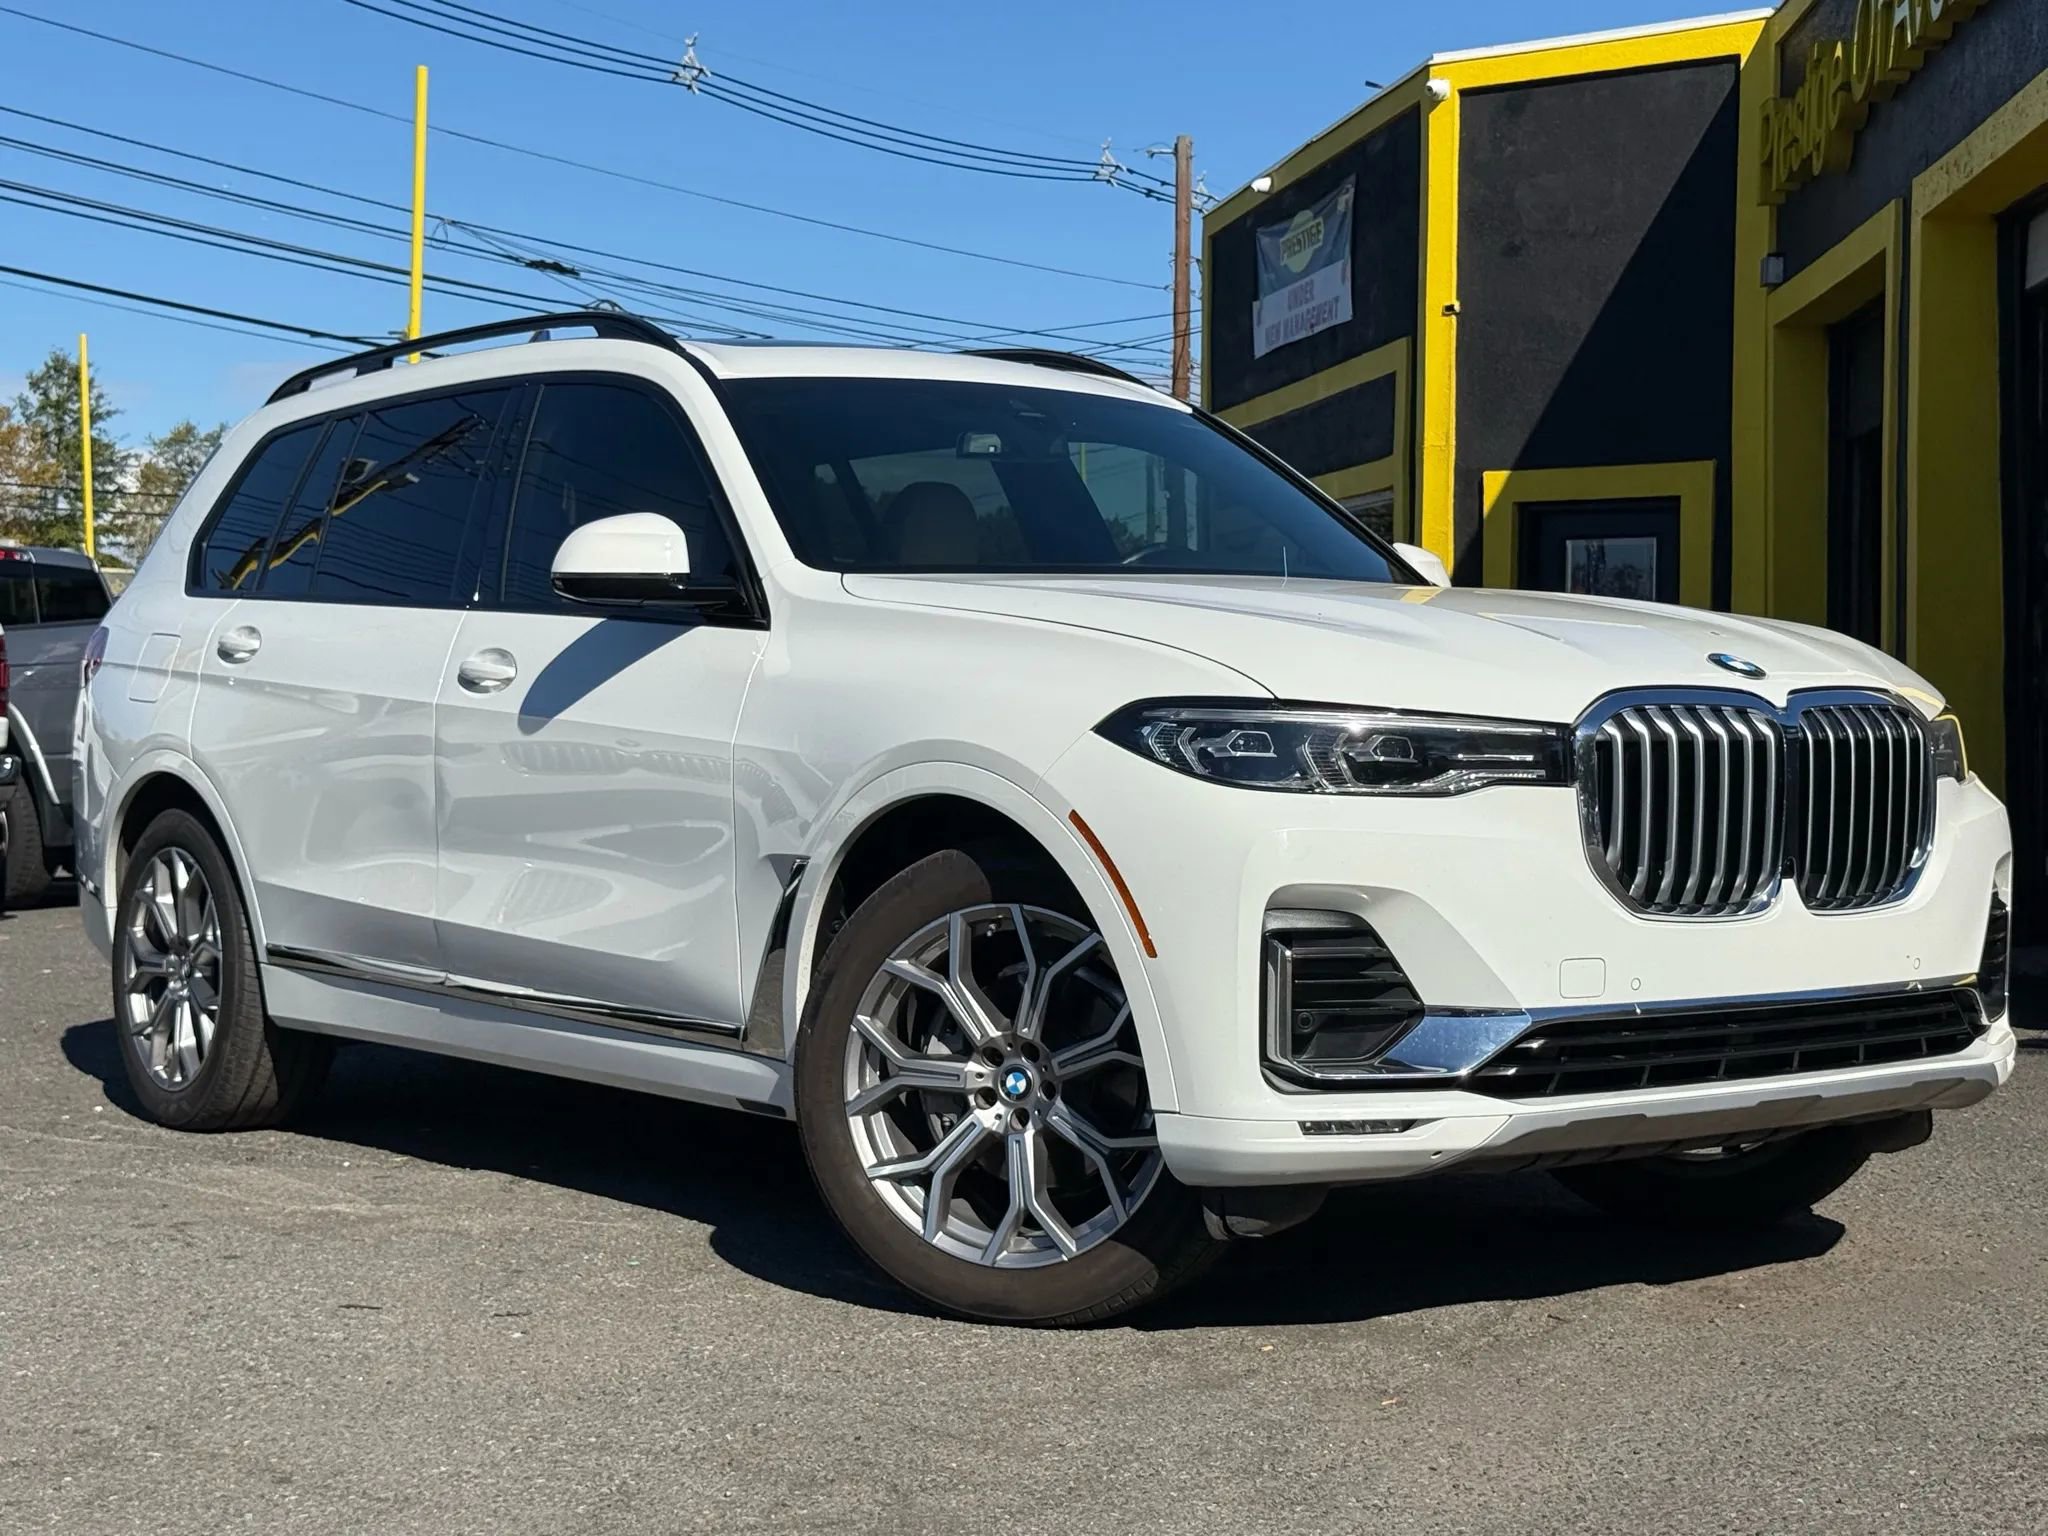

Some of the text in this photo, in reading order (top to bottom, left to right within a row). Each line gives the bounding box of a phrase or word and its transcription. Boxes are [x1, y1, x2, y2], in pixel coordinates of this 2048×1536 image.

[1758, 40, 1845, 205] Prestige
[1281, 221, 1322, 259] PRESTIGE
[1283, 296, 1340, 340] MANAGEMENT
